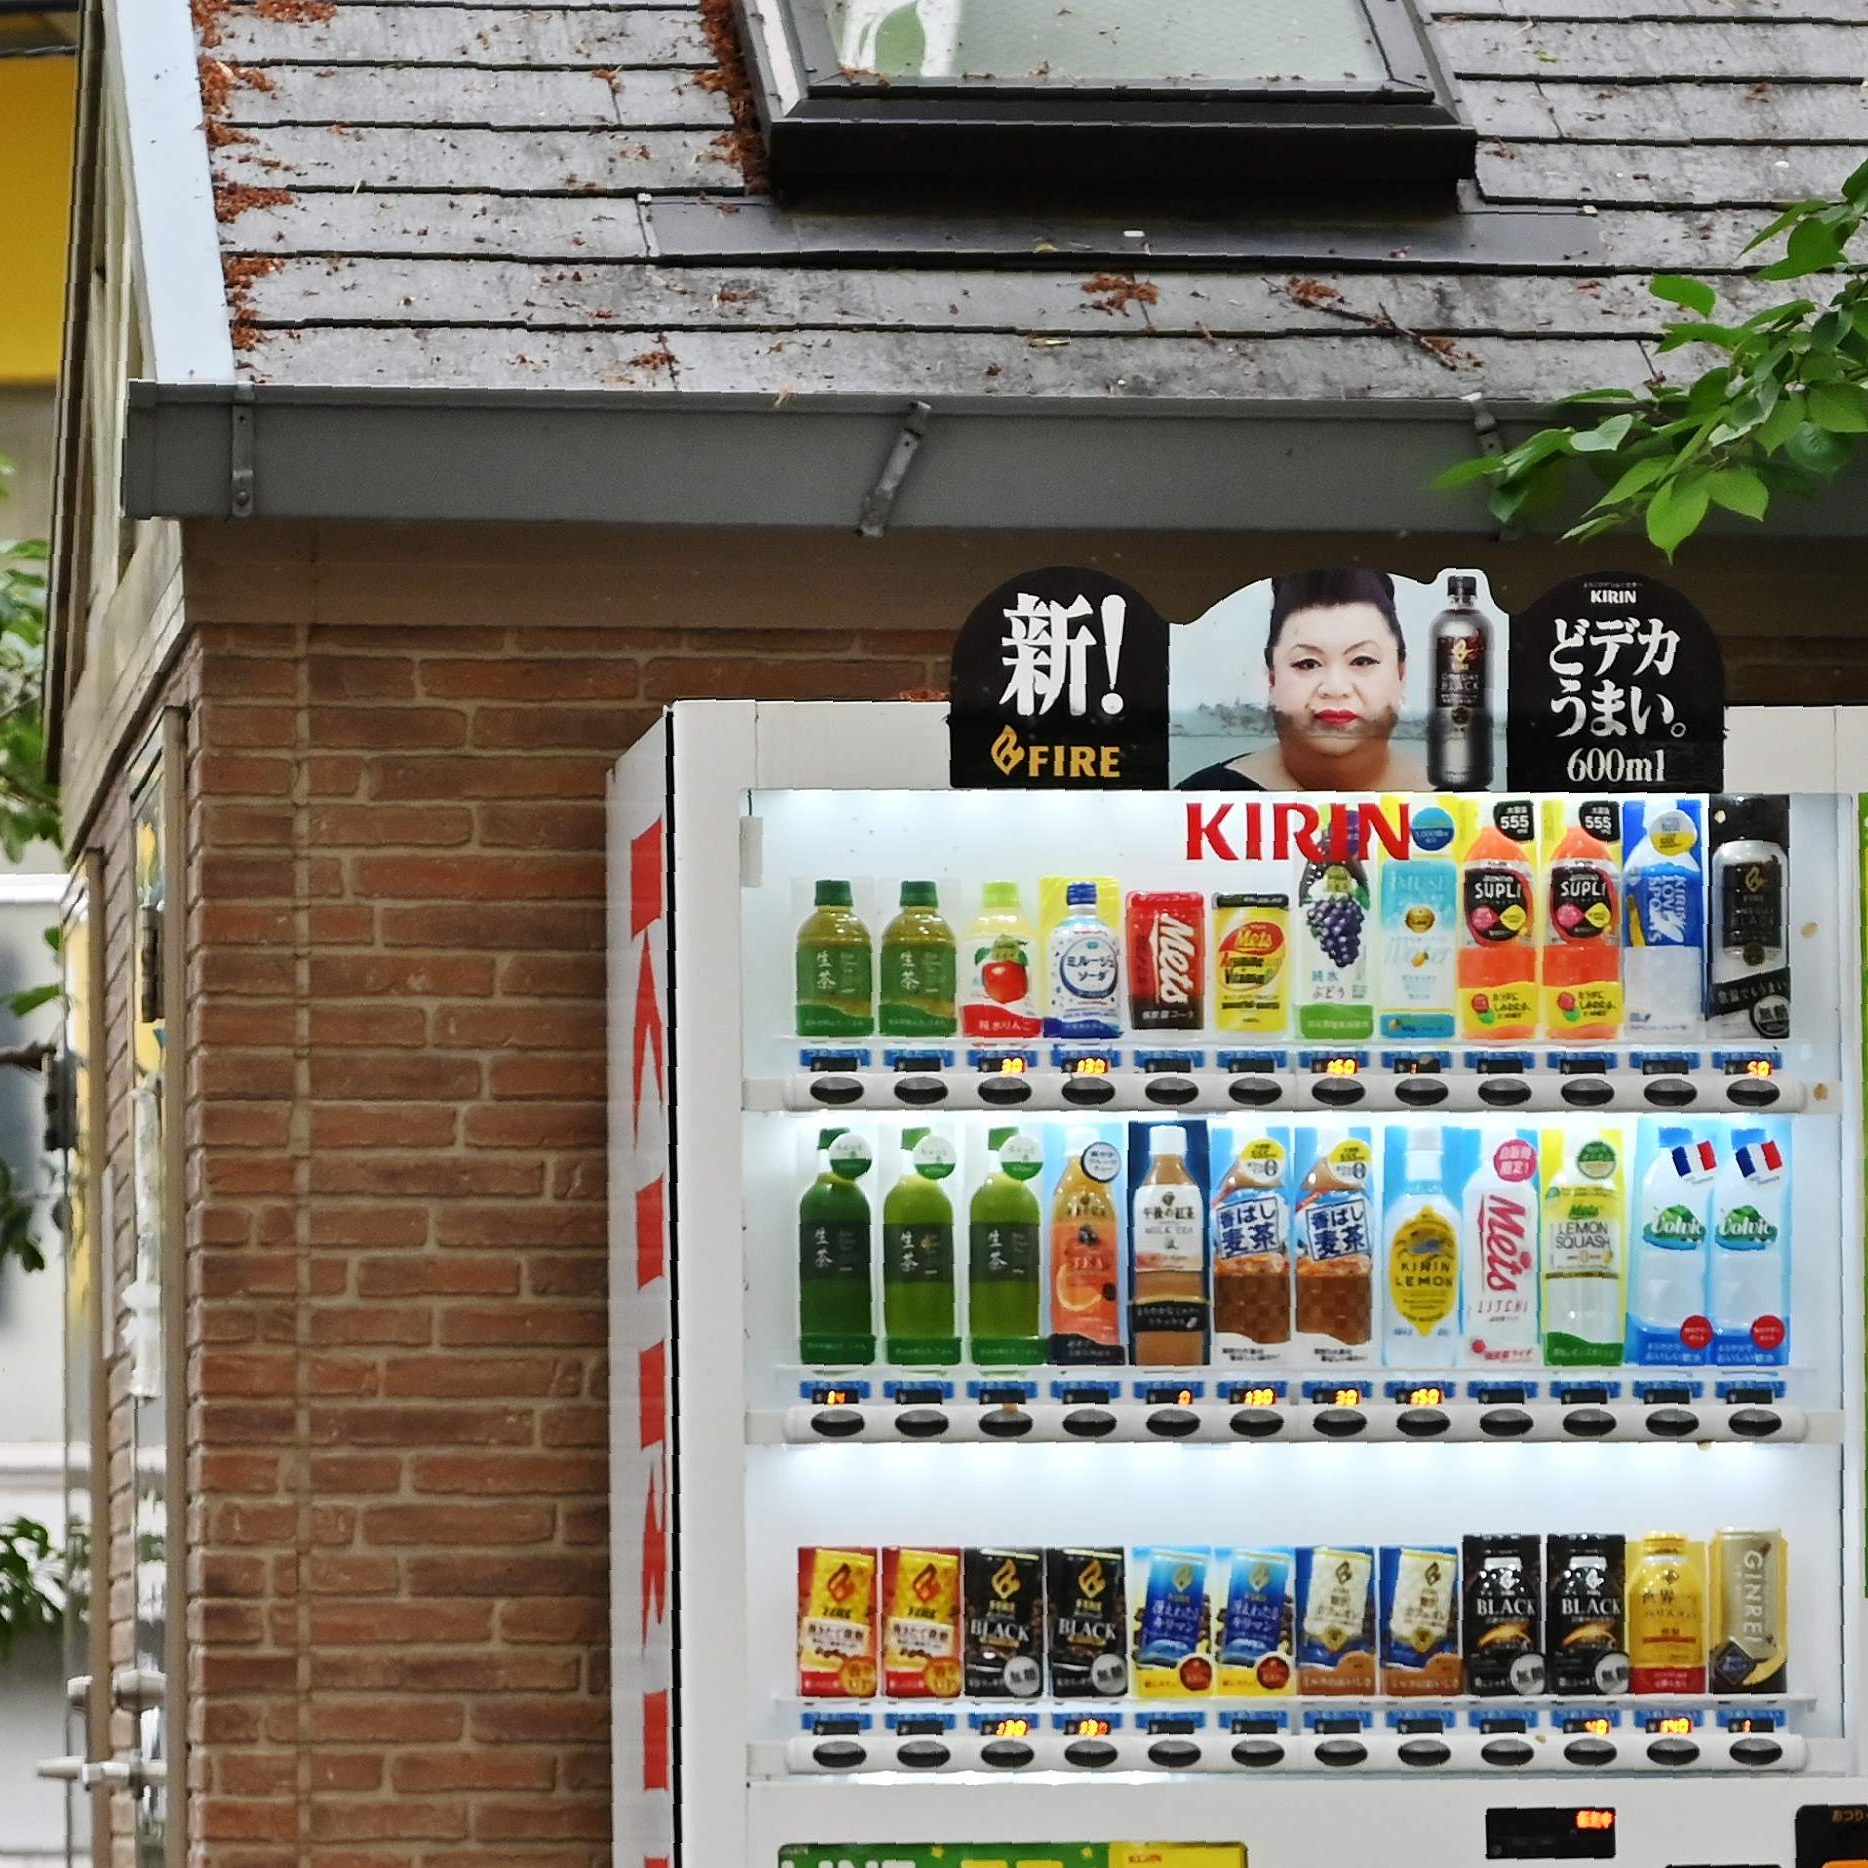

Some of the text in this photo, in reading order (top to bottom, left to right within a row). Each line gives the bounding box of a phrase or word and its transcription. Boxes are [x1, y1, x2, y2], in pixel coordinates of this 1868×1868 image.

[1590, 590, 1637, 603] KIRIN
[1001, 594, 1126, 717] 新!
[1552, 619, 1680, 677] どデカ
[1551, 679, 1688, 740] うまい。
[1030, 747, 1120, 777] FIRE
[1568, 747, 1666, 782] 600ml
[1185, 802, 1411, 861] KIRIN
[1500, 816, 1530, 830] 555
[1585, 816, 1612, 830] 555
[816, 950, 836, 990] 生茶
[899, 951, 921, 989] 生茶
[1158, 913, 1196, 1005] Mets
[1222, 1223, 1277, 1252] 麦茶
[1314, 1225, 1366, 1256] 麦茶
[1555, 1236, 1611, 1250] SQUASH
[1558, 1222, 1608, 1236] LEMON
[814, 1227, 834, 1268] 生茶
[900, 1231, 920, 1272] 生茶
[988, 1230, 1008, 1272] 生茶
[1396, 1276, 1454, 1288] LEMON
[1400, 1262, 1451, 1274] KIRIN
[1476, 1598, 1537, 1616] BLACK
[1561, 1597, 1621, 1616] BLACK
[1743, 1549, 1763, 1642] GINREI
[970, 1618, 1029, 1642] BLACK
[1057, 1617, 1117, 1640] BLACK
